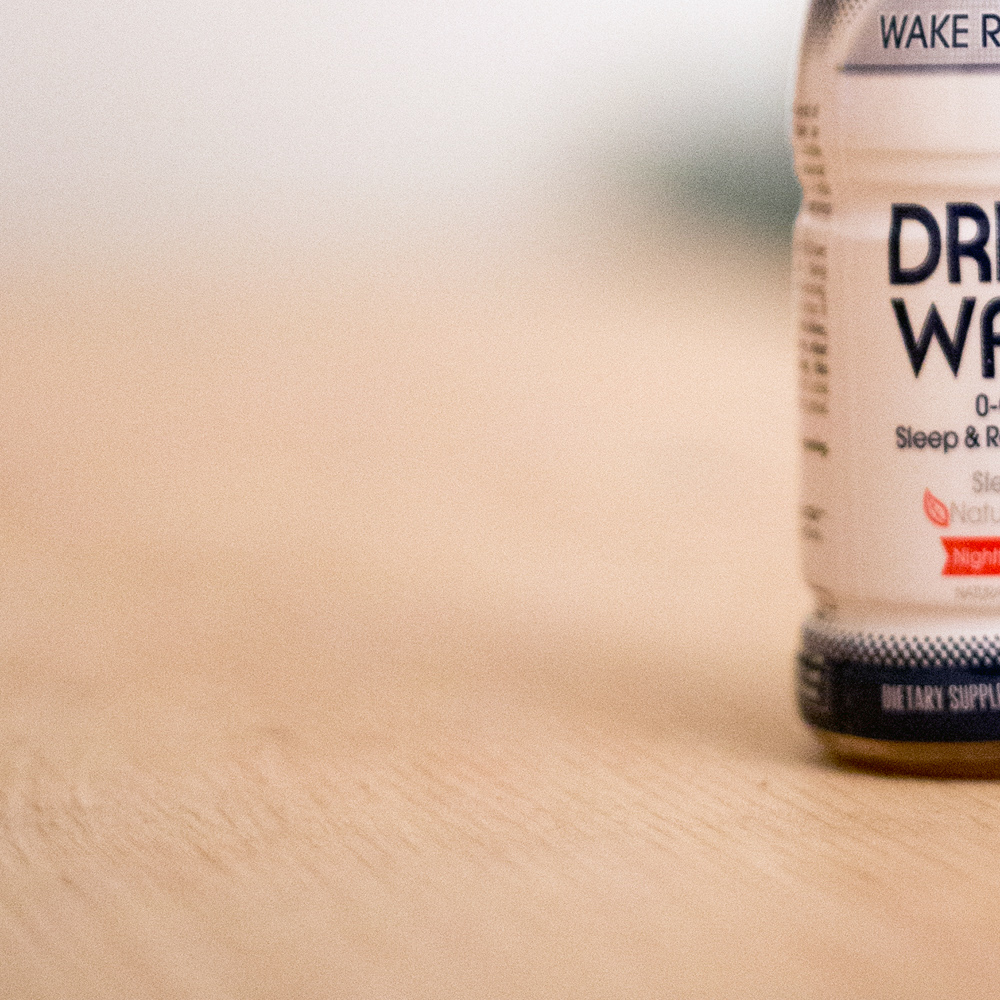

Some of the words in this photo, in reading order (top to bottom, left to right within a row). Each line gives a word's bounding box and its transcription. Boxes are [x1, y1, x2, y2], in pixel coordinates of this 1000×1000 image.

[880, 13, 969, 49] WAKE
[895, 425, 959, 453] Sleep
[964, 426, 981, 449] &
[881, 683, 943, 712] DIETARY
